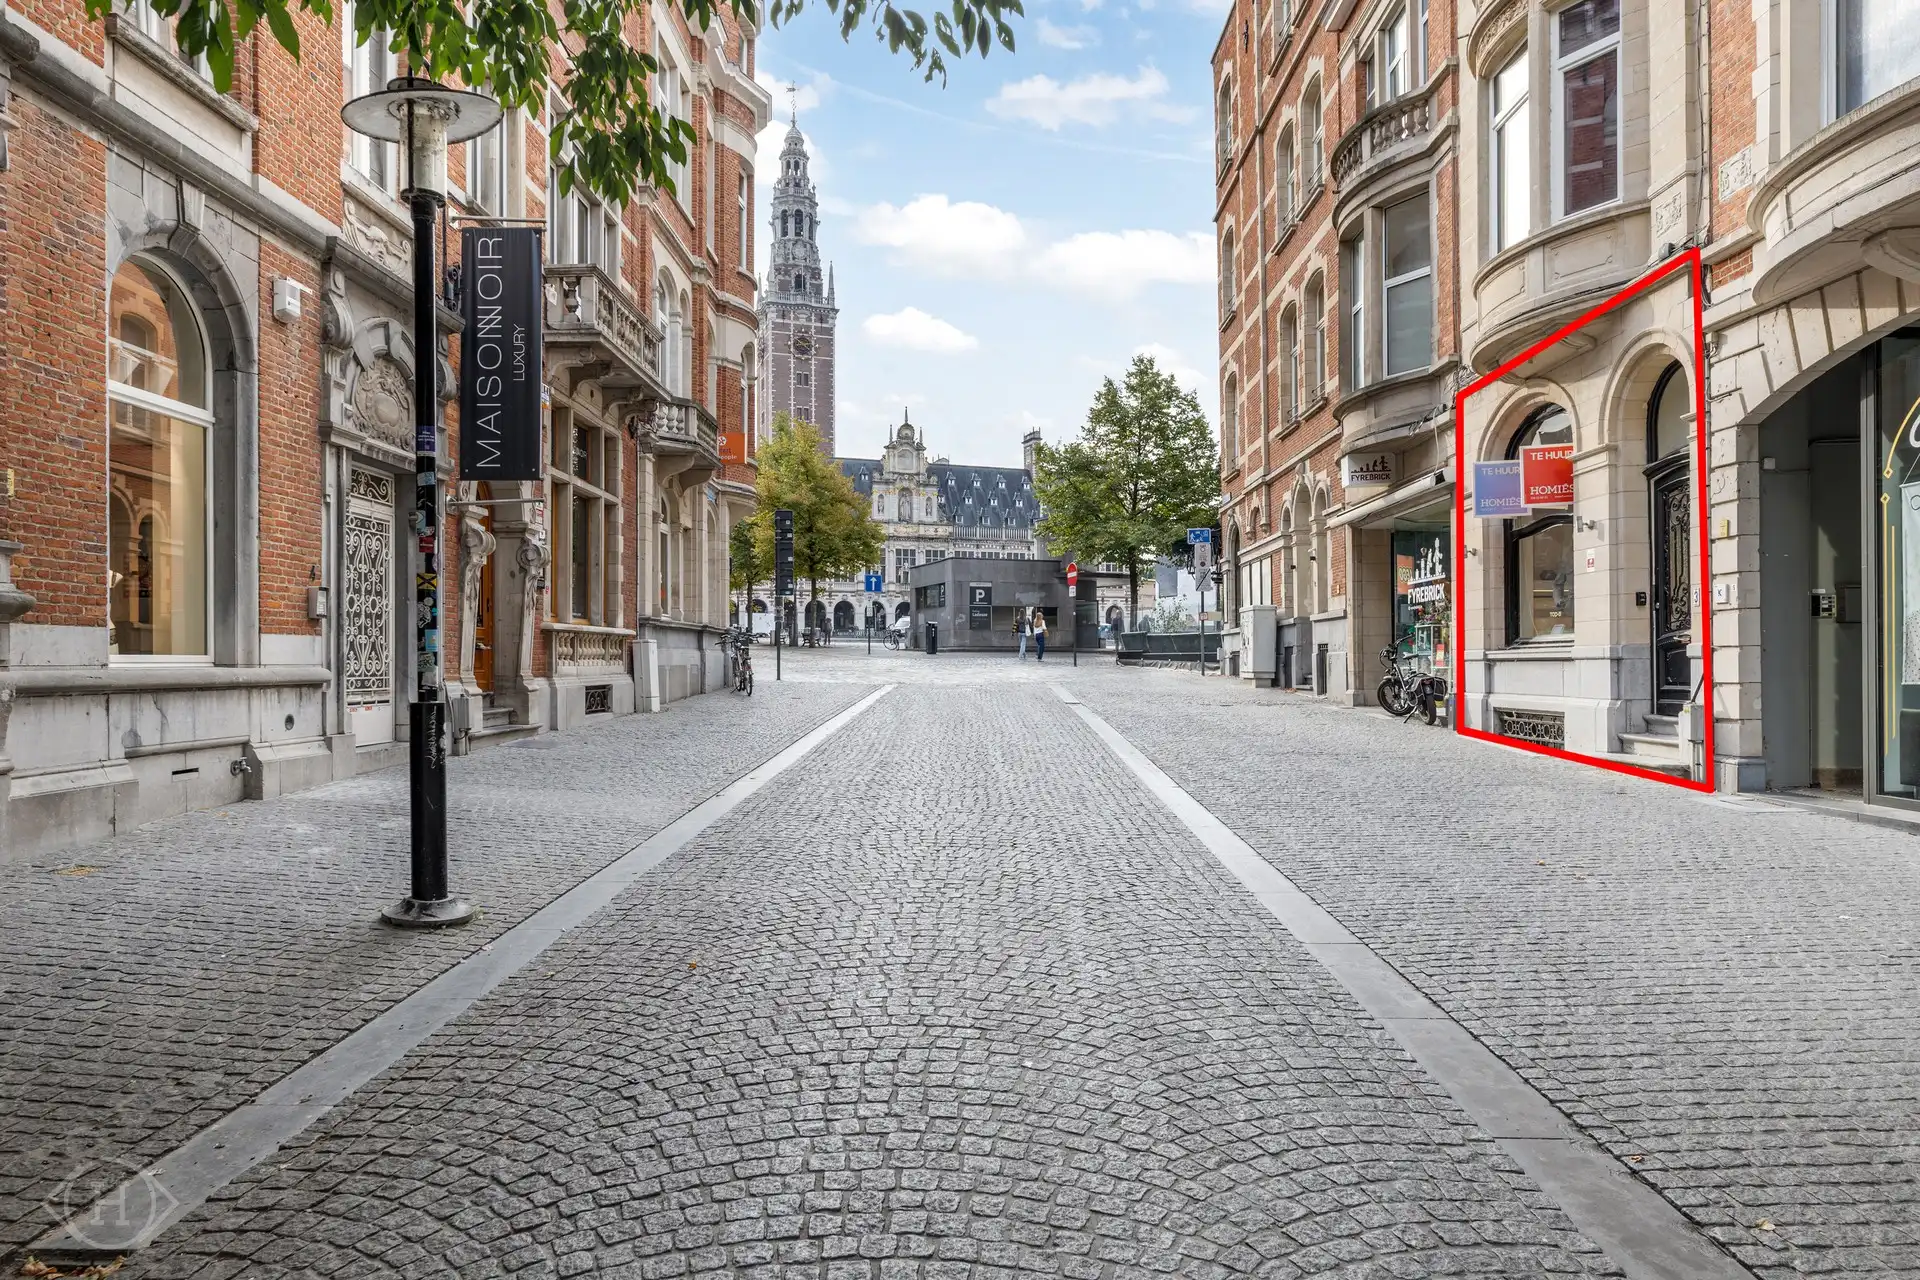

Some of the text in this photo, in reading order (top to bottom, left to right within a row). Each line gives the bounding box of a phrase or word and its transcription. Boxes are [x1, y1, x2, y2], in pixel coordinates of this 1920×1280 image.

[513, 323, 525, 381] LUXURY
[1530, 452, 1543, 460] TE
[1481, 466, 1520, 476] TE HUUR
[1351, 473, 1391, 482] FYREBRICK
[975, 589, 985, 602] P
[1407, 582, 1446, 605] FYREBRICK
